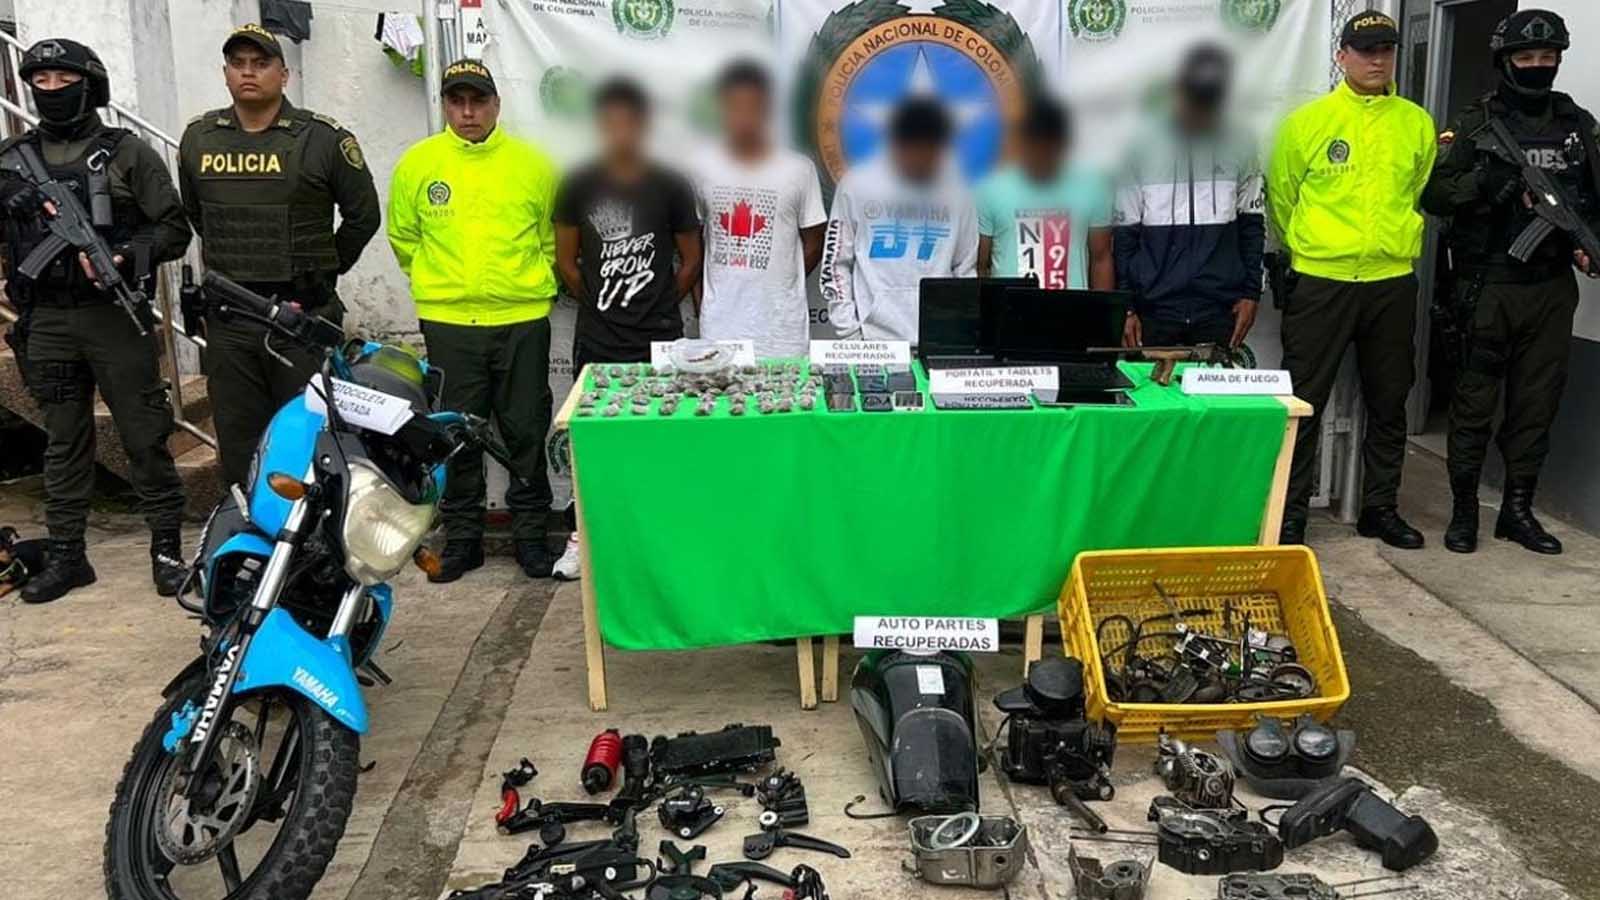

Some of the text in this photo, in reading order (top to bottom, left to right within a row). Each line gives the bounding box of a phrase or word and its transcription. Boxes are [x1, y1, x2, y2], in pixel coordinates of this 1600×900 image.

[533, 3, 595, 16] DE COLOMBIA
[863, 22, 940, 54] NACIONAL
[943, 26, 964, 43] DE
[444, 62, 490, 79] POLICIA
[200, 153, 281, 173] POLICIA
[1521, 148, 1568, 171] OES
[600, 233, 656, 259] NEVER
[821, 219, 839, 286] YAMAHA
[600, 250, 656, 278] GROW
[597, 270, 656, 311] UP
[824, 351, 897, 360] RECUPERADOS
[831, 342, 889, 351] CELULARES
[1007, 367, 1052, 376] TABLETS
[1197, 373, 1280, 384] ARMA DE FUEGO
[964, 379, 1034, 388] RECUPERADA
[332, 382, 387, 406] OTOCICLETA
[878, 618, 986, 631] AUTO PARTES
[873, 635, 991, 650] RECUPERADAS
[190, 645, 240, 743] YAMAHA
[292, 666, 339, 708] YAMAHA
